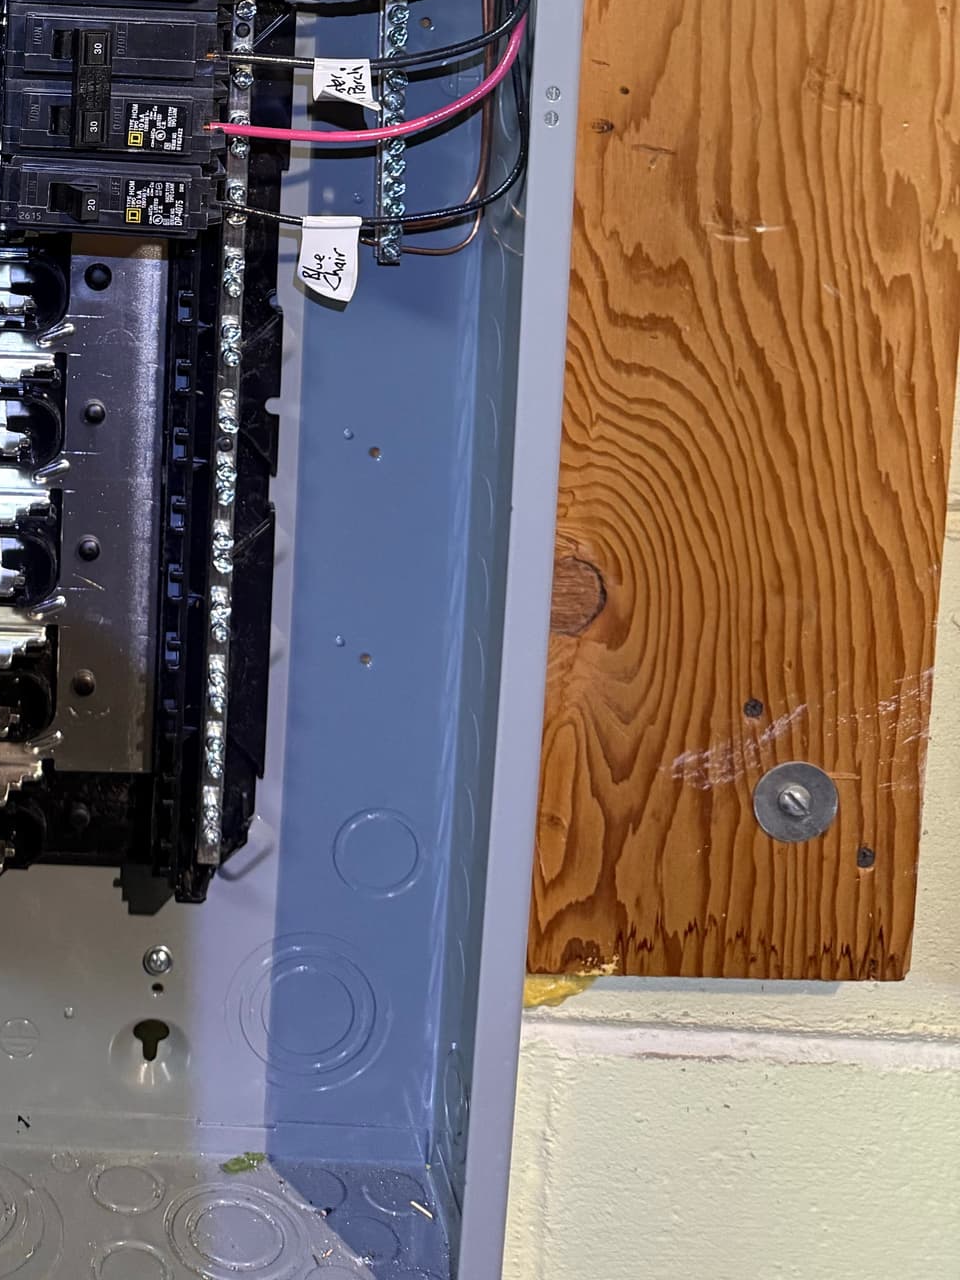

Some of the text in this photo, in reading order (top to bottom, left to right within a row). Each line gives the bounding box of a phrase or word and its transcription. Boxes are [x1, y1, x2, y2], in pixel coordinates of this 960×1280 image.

[93, 42, 103, 55] 30
[89, 121, 98, 133] 30
[87, 198, 96, 211] 20
[174, 199, 183, 225] DP-4075
